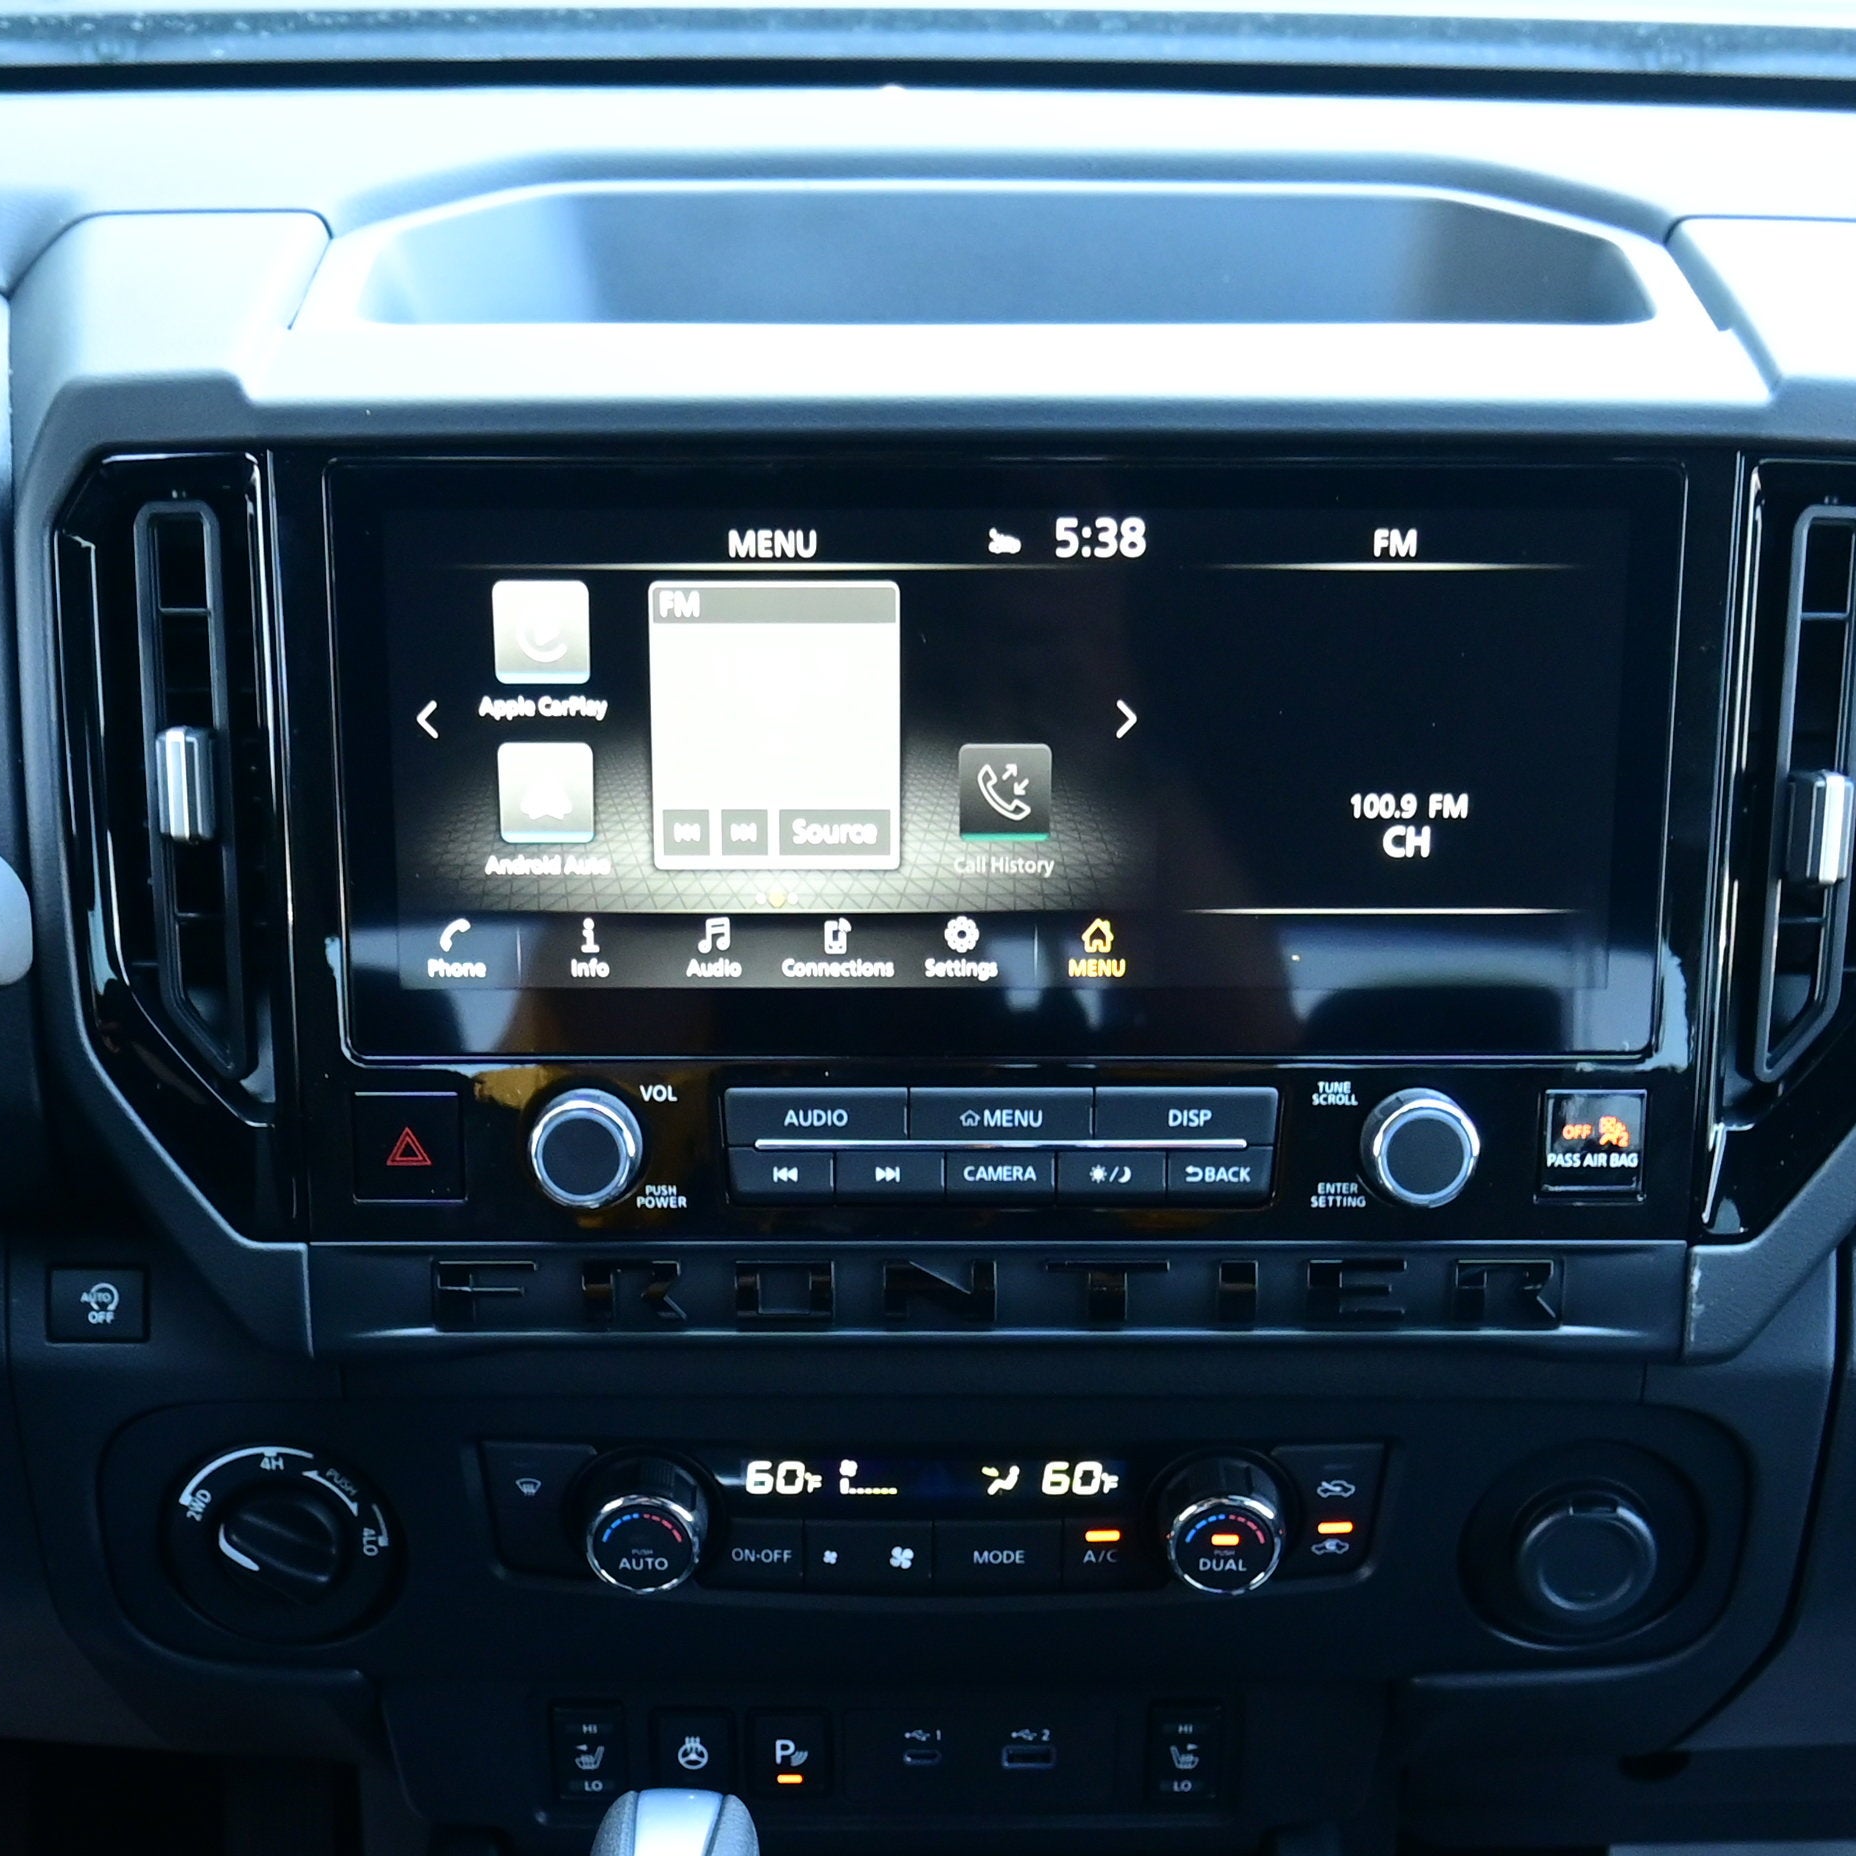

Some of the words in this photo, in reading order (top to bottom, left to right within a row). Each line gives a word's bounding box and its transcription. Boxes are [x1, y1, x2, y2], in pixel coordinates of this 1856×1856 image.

[728, 529, 817, 558] MENU
[1054, 516, 1147, 558] 5:38
[1372, 528, 1417, 557] FM
[659, 590, 701, 617] FM
[478, 695, 536, 721] Apple
[538, 695, 608, 721] CarPlay
[1350, 793, 1416, 819] 100.9
[1428, 793, 1469, 818] FM
[792, 818, 877, 845] Source
[1382, 825, 1431, 859] CH
[485, 854, 562, 876] Android
[564, 854, 611, 876] Auto
[953, 857, 988, 875] Call
[991, 856, 1055, 879] History
[427, 957, 486, 978] Phone
[571, 957, 610, 978] Info
[685, 957, 742, 978] Audio
[781, 957, 895, 979] Connections
[924, 957, 999, 982] Settings
[1068, 958, 1126, 978] MENU
[639, 1085, 678, 1103] VOL
[1317, 1081, 1351, 1094] TUNE
[1311, 1093, 1358, 1106] SCROLL
[783, 1109, 848, 1128] AUDIO
[983, 1109, 1043, 1128] MENU
[1168, 1108, 1212, 1127] DISP
[1562, 1124, 1591, 1140] OFF
[1546, 1152, 1580, 1168] PASS
[1583, 1152, 1607, 1167] AIR
[1610, 1152, 1638, 1168] BAG
[963, 1165, 1036, 1182] CAMERA
[1204, 1166, 1251, 1183] BACK
[645, 1185, 677, 1196] PUSH
[1317, 1183, 1358, 1195] ENTER
[636, 1196, 687, 1209] POWER
[1310, 1195, 1366, 1208] SETTING
[80, 1291, 112, 1304] AUTO
[434, 1258, 1564, 1331] FRONTIER
[88, 1311, 115, 1325] OFF
[259, 1454, 285, 1471] 4H
[186, 1489, 212, 1522] 2WD
[619, 1557, 668, 1571] AUTO
[973, 1550, 1025, 1564] MODE
[1083, 1550, 1118, 1564] A/C
[1199, 1557, 1247, 1572] DUAL
[582, 1724, 597, 1734] HI
[1041, 1730, 1050, 1741] 2
[1178, 1724, 1193, 1734] HI
[584, 1781, 603, 1792] LO
[1173, 1781, 1192, 1792] LO
